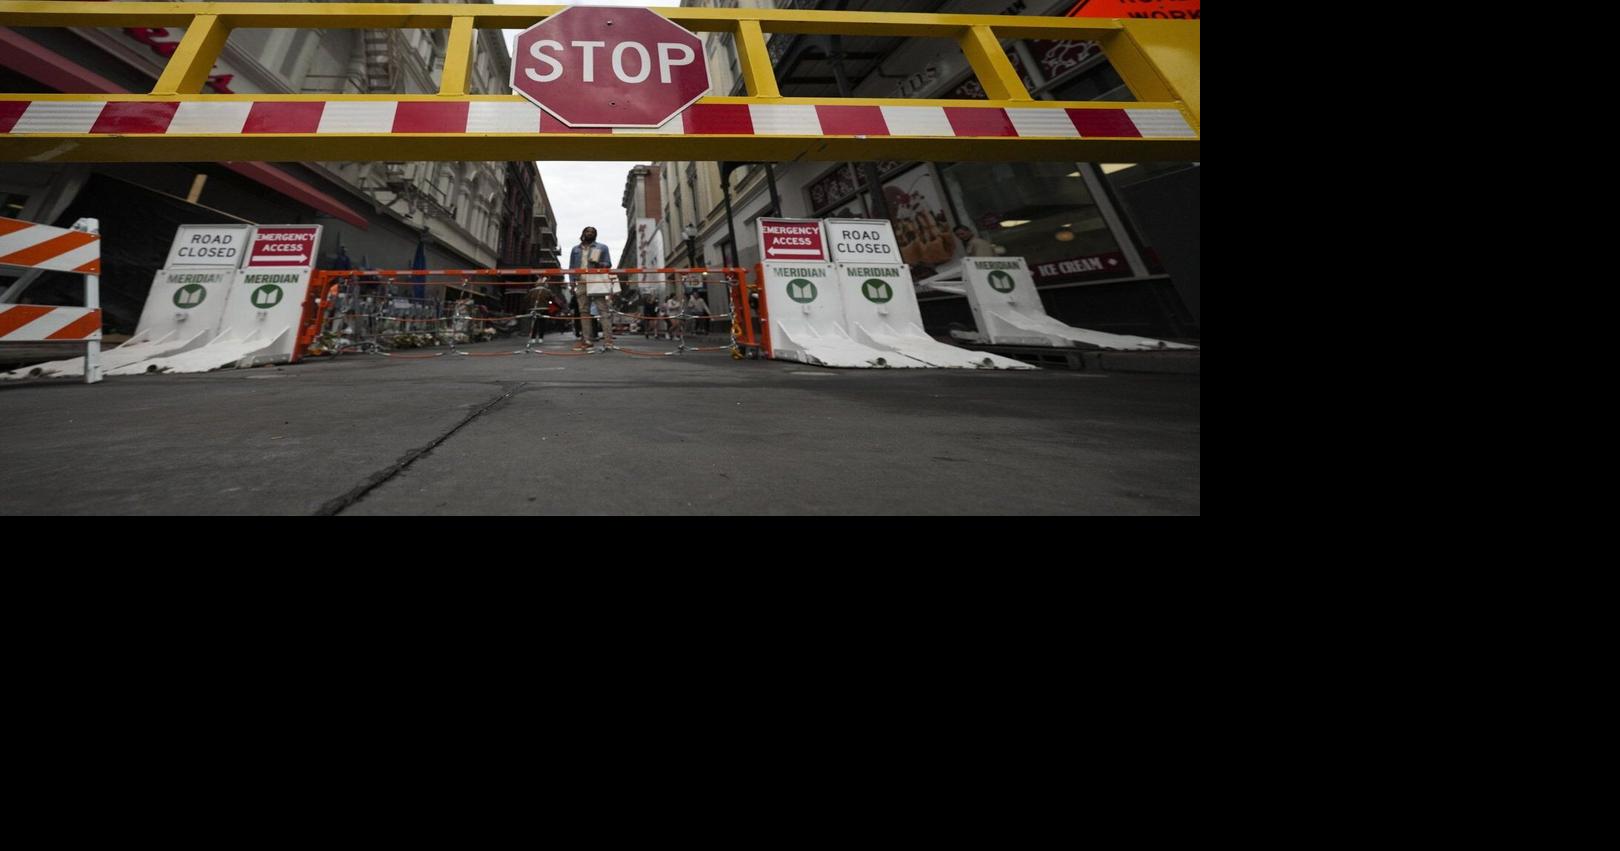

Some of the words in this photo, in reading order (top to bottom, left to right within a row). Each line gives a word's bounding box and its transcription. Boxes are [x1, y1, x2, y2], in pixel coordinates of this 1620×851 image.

[525, 40, 695, 83] STOP
[762, 226, 820, 235] EMERGENCY
[842, 230, 880, 241] ROAD
[190, 234, 232, 245] ROAD
[255, 233, 316, 241] EMERGENCY
[772, 237, 812, 245] ACCESS
[178, 247, 236, 258] CLOSED
[262, 243, 304, 252] ACCESS
[837, 243, 891, 254] CLOSED
[974, 261, 1022, 270] MERIDIAN
[1037, 264, 1058, 277] ICE
[1059, 257, 1104, 274] CREAM
[773, 267, 827, 278] MERIDIAN
[847, 267, 900, 277] MERIDIAN
[166, 273, 224, 284] MERIDIAN
[244, 274, 299, 284] MERIDIAN
